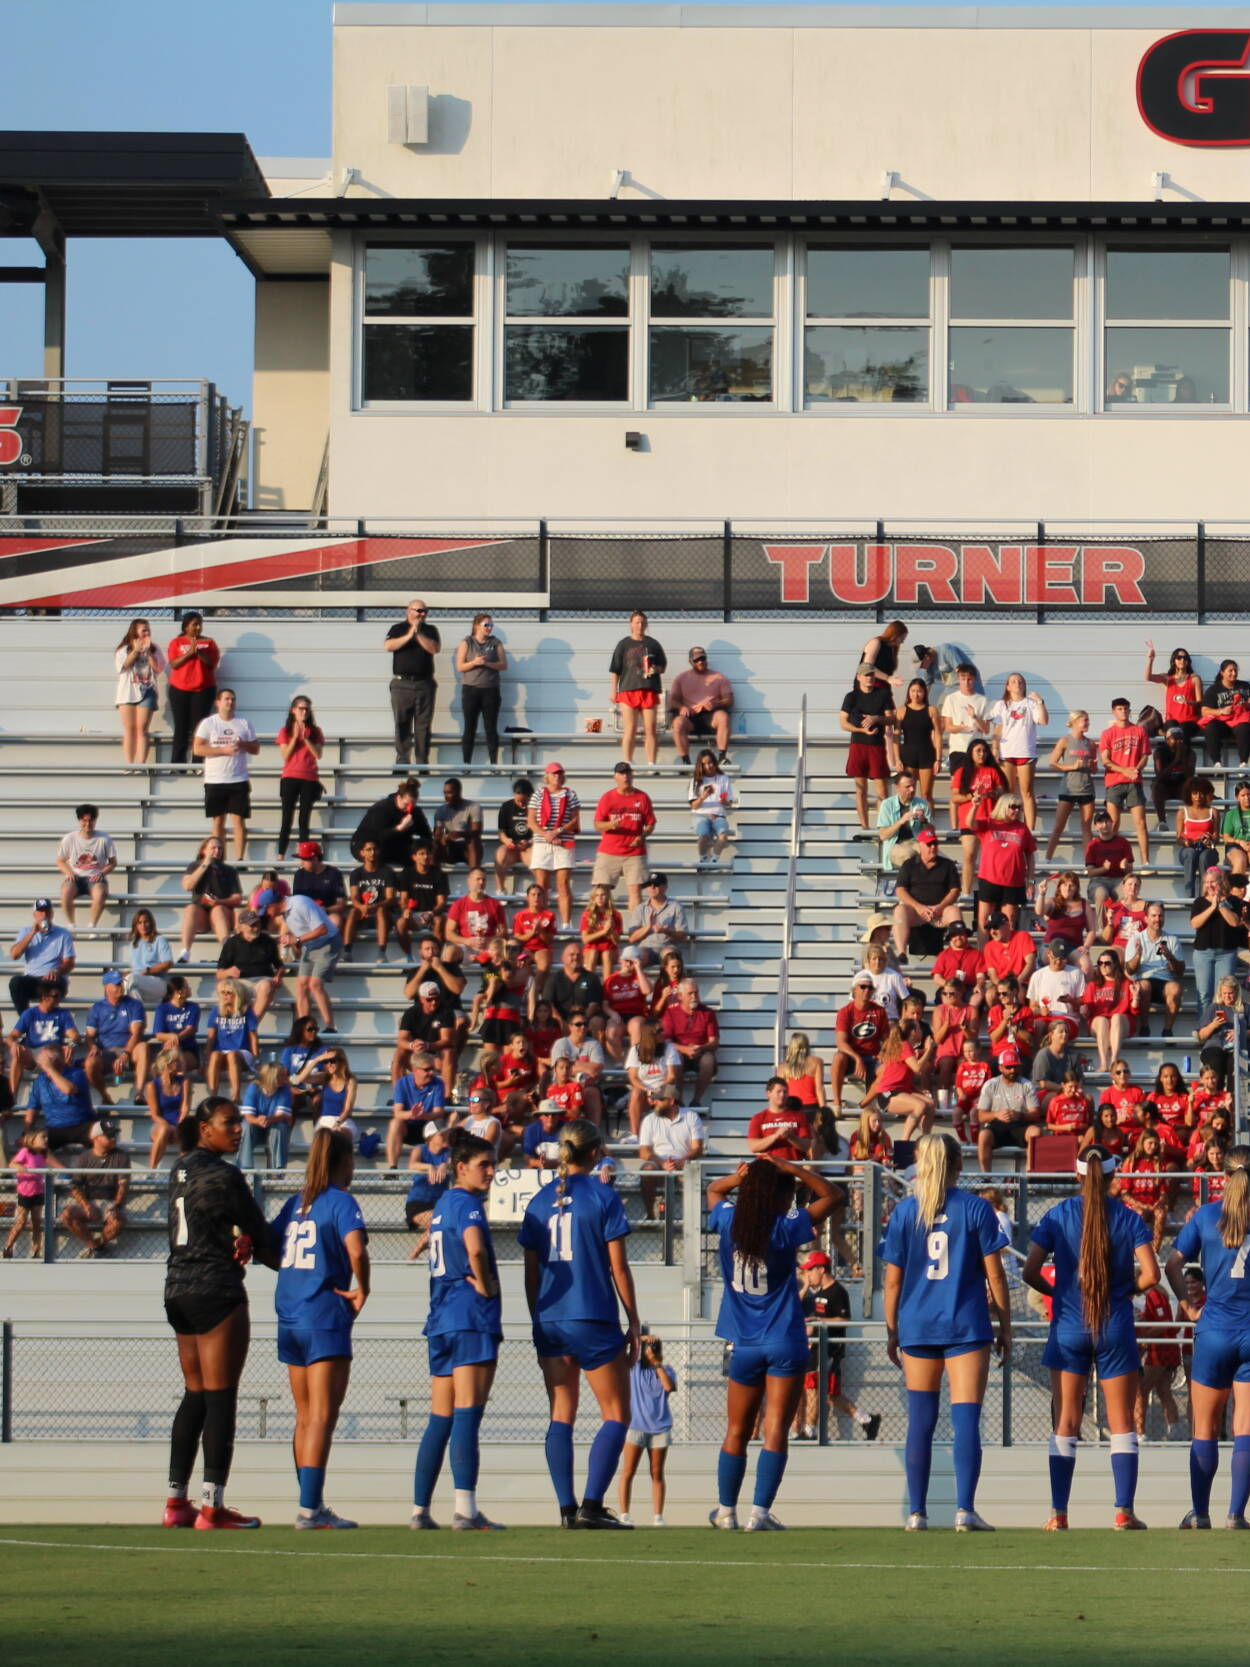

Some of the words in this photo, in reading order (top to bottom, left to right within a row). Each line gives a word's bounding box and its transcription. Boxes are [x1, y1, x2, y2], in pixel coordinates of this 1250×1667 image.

[762, 544, 1147, 605] TURNER
[175, 1197, 188, 1246] 1
[548, 1212, 573, 1262] 11
[731, 1250, 768, 1296] 10
[927, 1231, 949, 1280] 9
